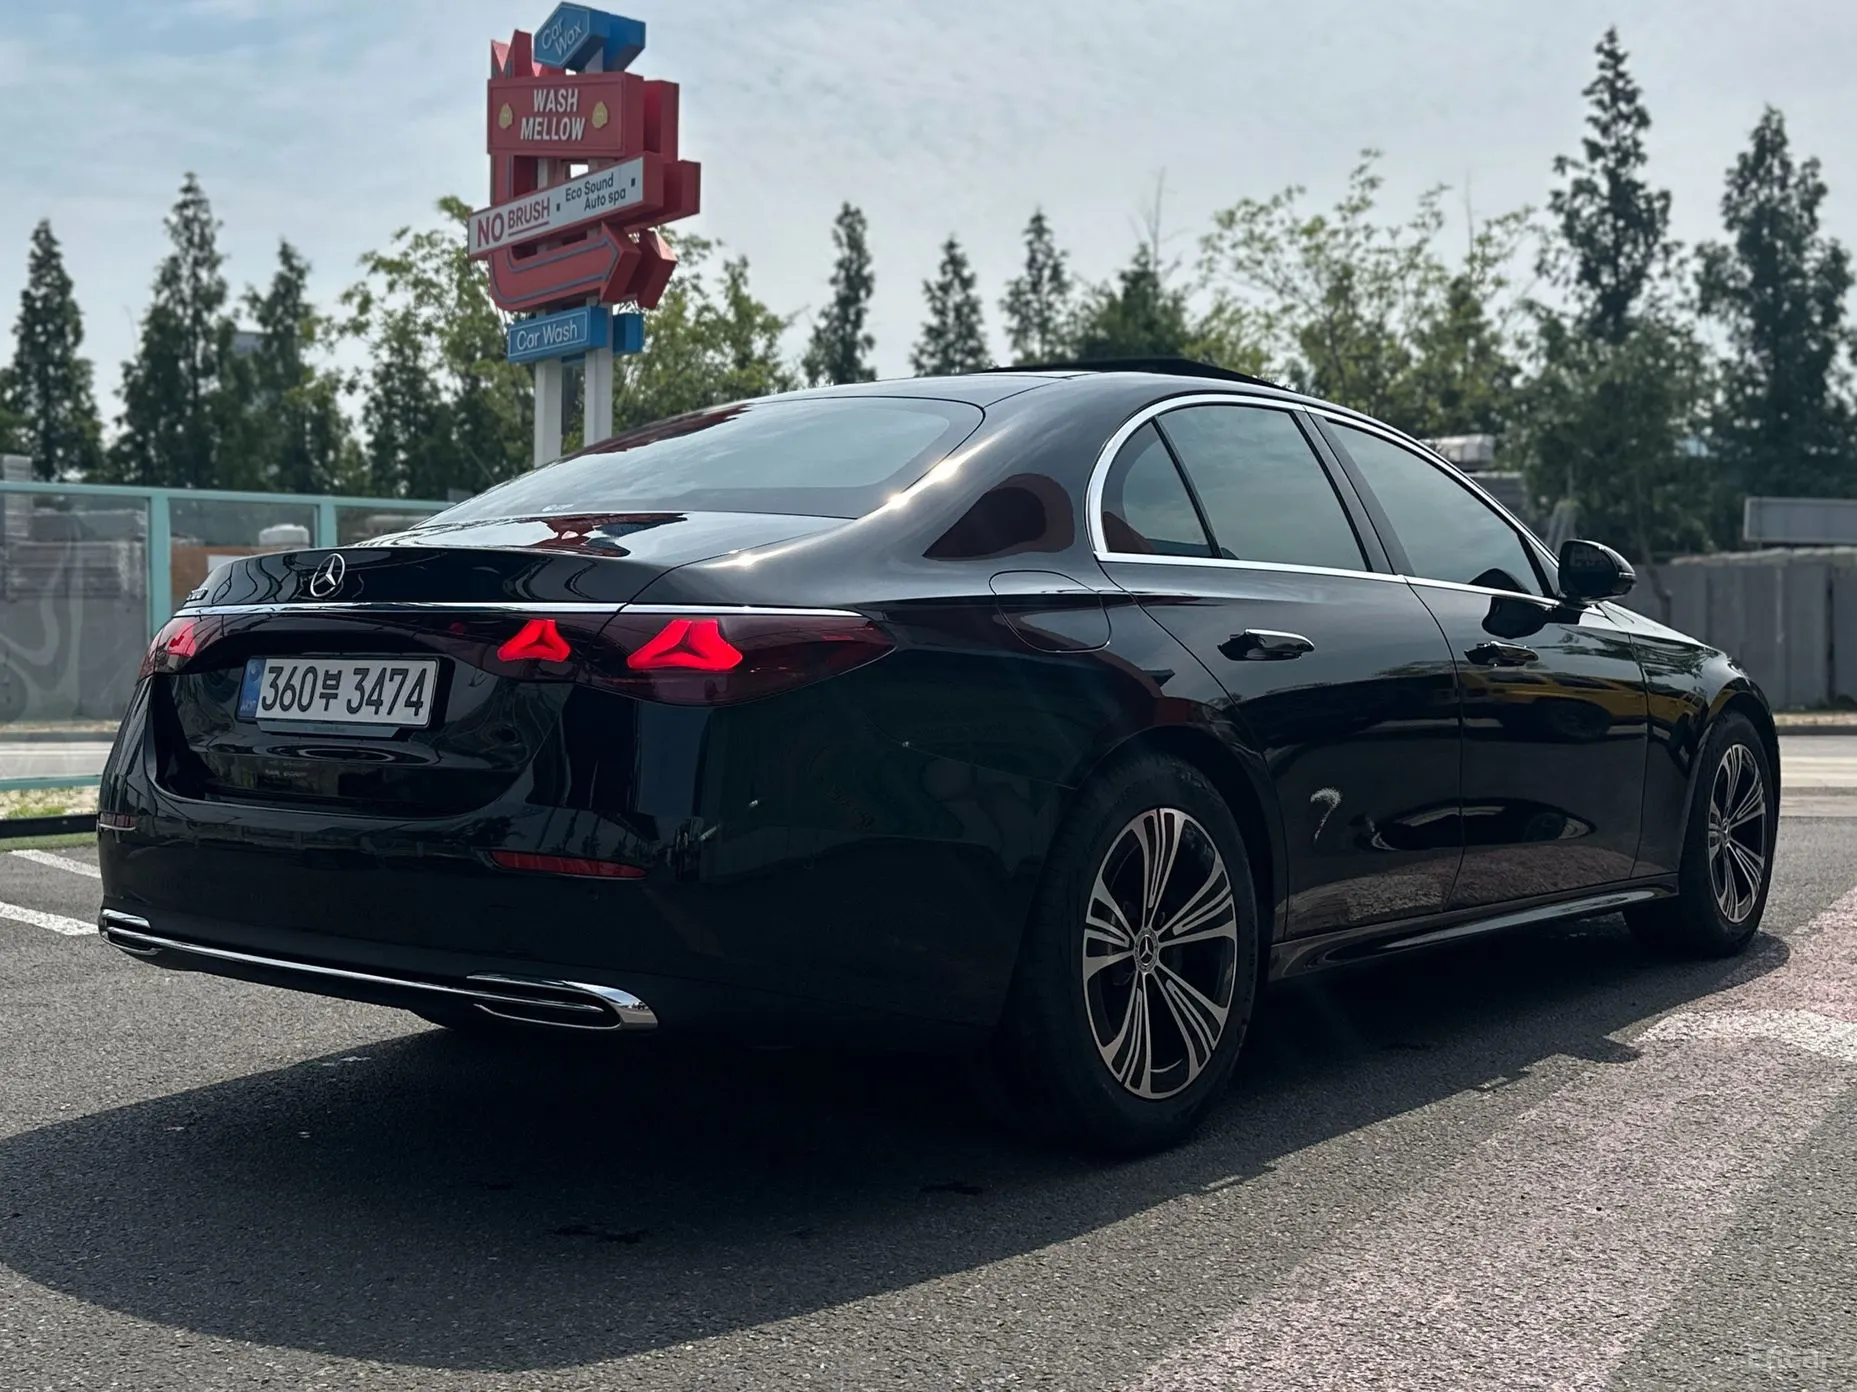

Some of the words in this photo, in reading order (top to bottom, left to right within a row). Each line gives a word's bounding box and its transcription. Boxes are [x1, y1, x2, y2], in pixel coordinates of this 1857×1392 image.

[541, 18, 565, 50] Car
[554, 20, 583, 57] Wax
[533, 88, 579, 113] WASH
[520, 116, 587, 141] MELLOW
[565, 186, 583, 203] Eco
[584, 173, 614, 194] Sound
[584, 196, 606, 212] Auto
[608, 189, 627, 205] spa
[477, 212, 505, 248] NO
[507, 197, 551, 230] BRUSH
[516, 329, 541, 351] Car
[542, 320, 578, 346] Wash
[261, 665, 342, 713] 360부
[346, 667, 428, 717] 3474
